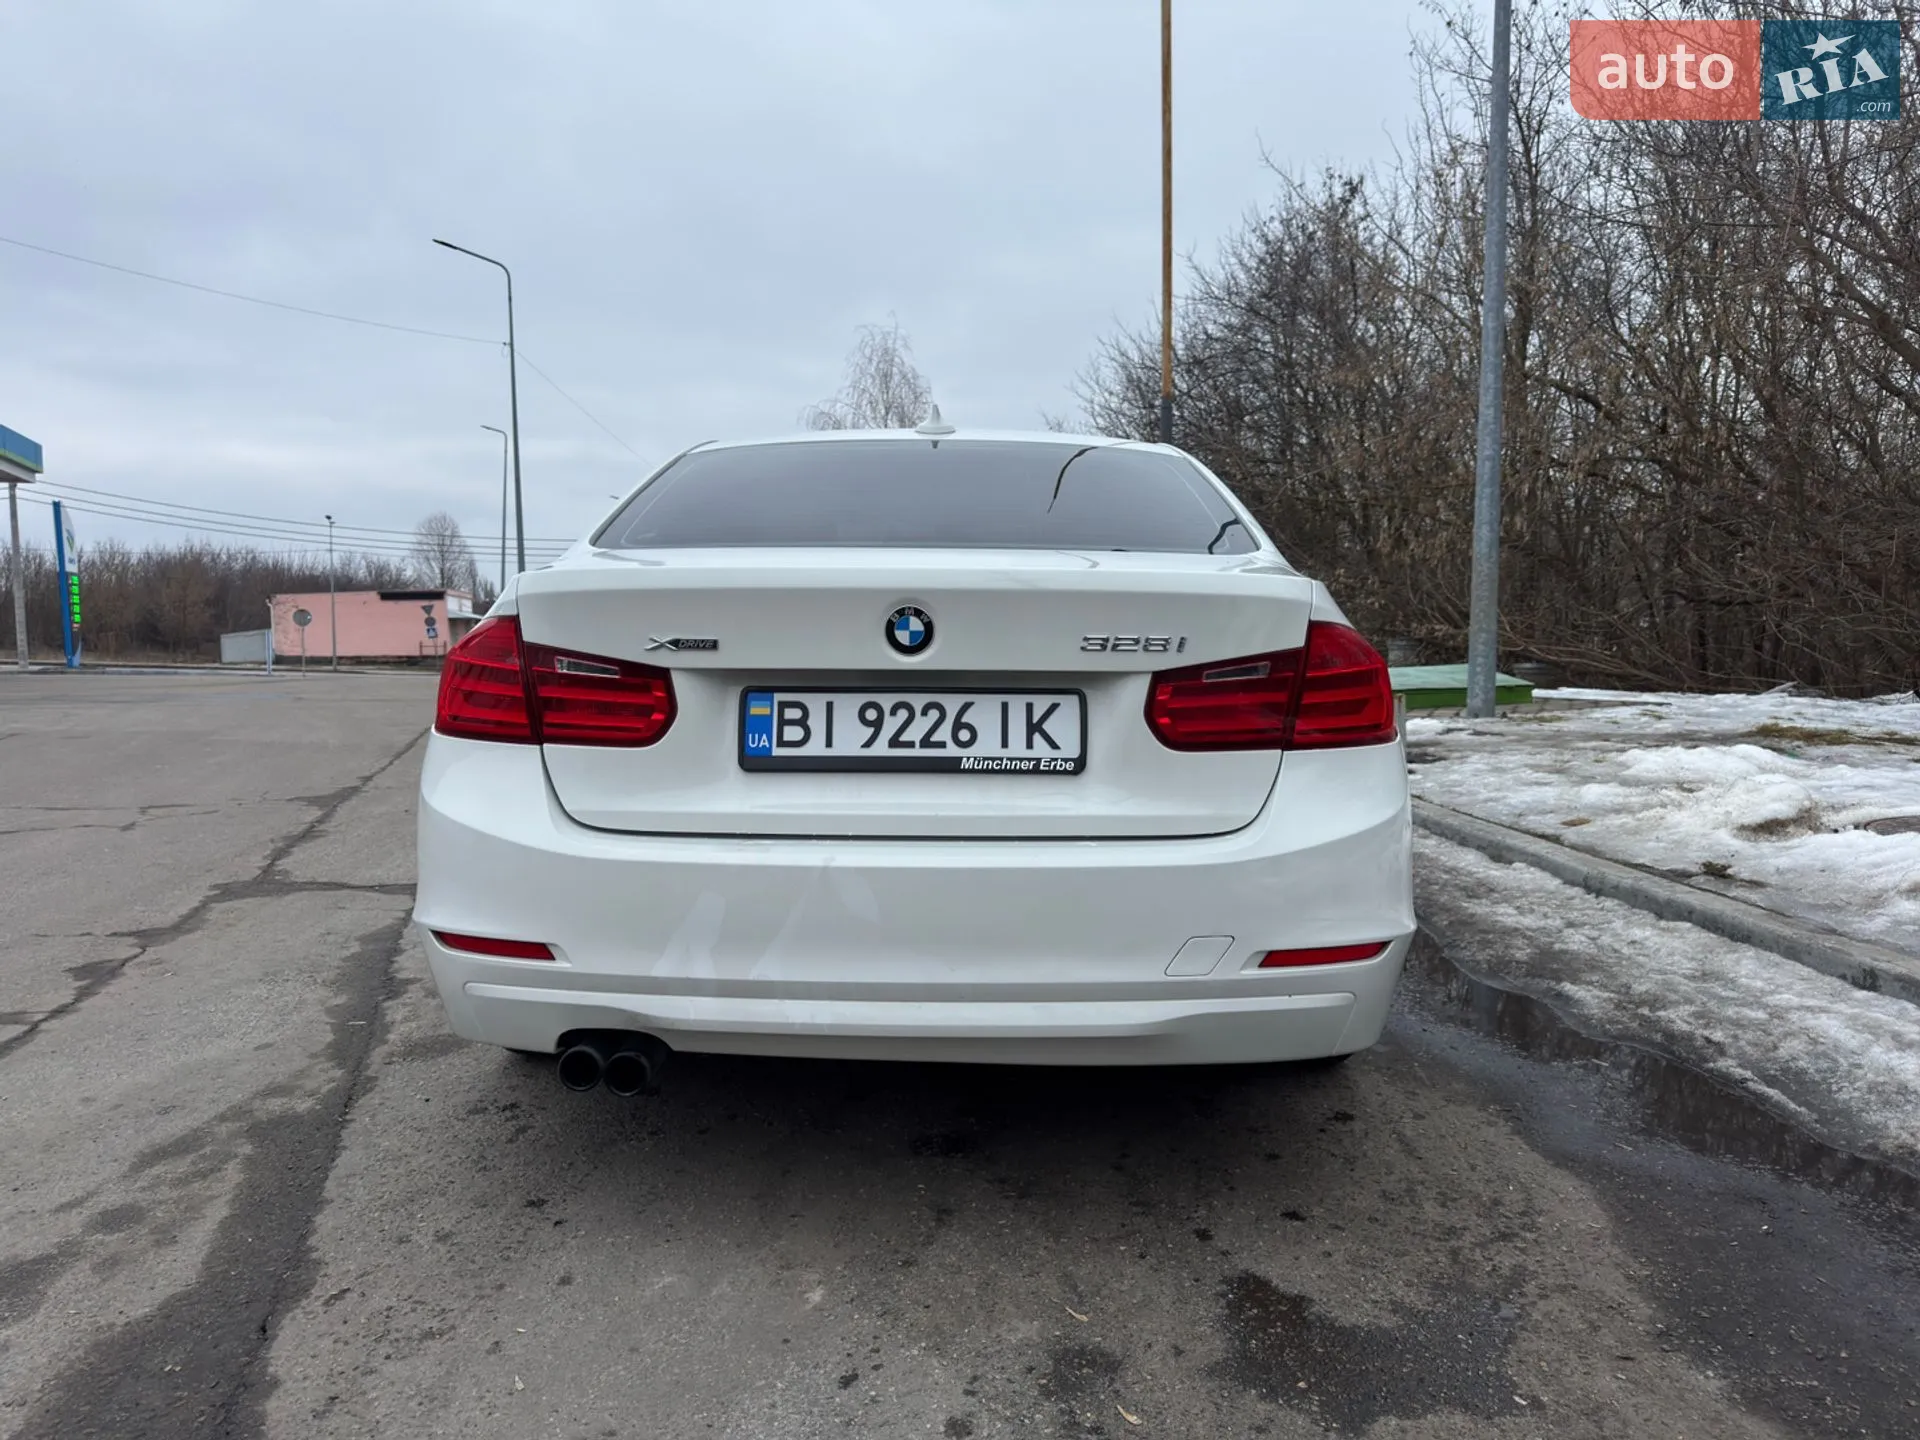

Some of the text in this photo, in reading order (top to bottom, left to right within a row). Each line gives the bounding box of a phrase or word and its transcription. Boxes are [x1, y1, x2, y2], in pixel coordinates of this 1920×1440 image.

[890, 606, 931, 623] BMW
[1080, 634, 1187, 653] 328i
[776, 701, 1062, 750] BI 9226 IK
[749, 733, 770, 748] UA
[960, 757, 1075, 771] Münchner Erbe
